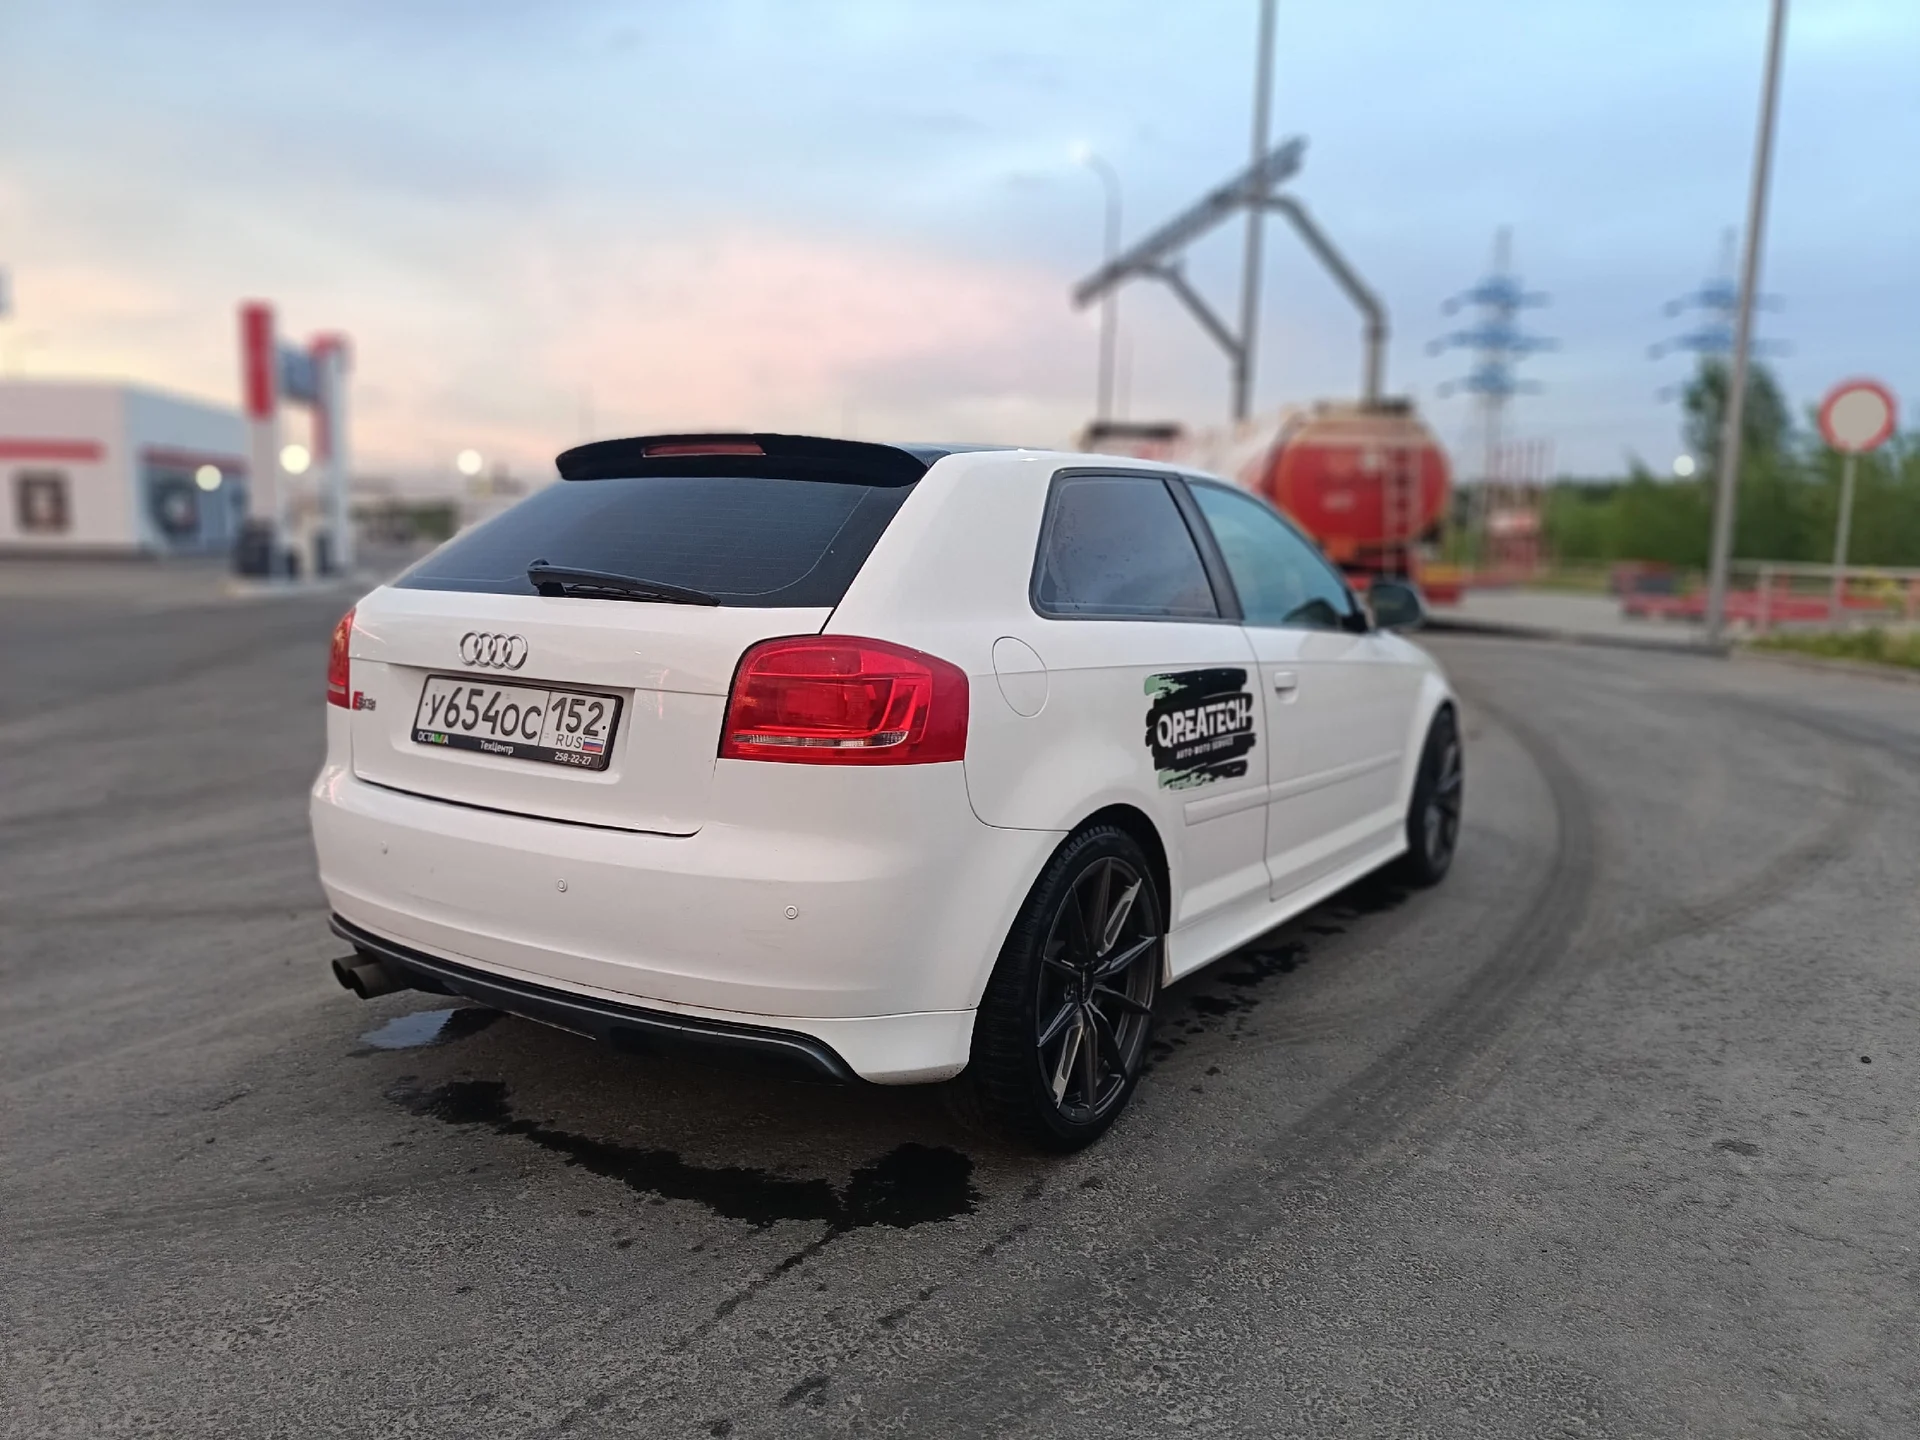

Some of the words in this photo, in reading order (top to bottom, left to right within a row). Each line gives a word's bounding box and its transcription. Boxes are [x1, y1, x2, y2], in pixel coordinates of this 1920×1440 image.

[427, 686, 541, 740] У654ОС
[551, 697, 604, 737] 152
[480, 740, 514, 756] ТехЦентр
[555, 734, 583, 749] RUS
[554, 751, 592, 765] 258-22-27
